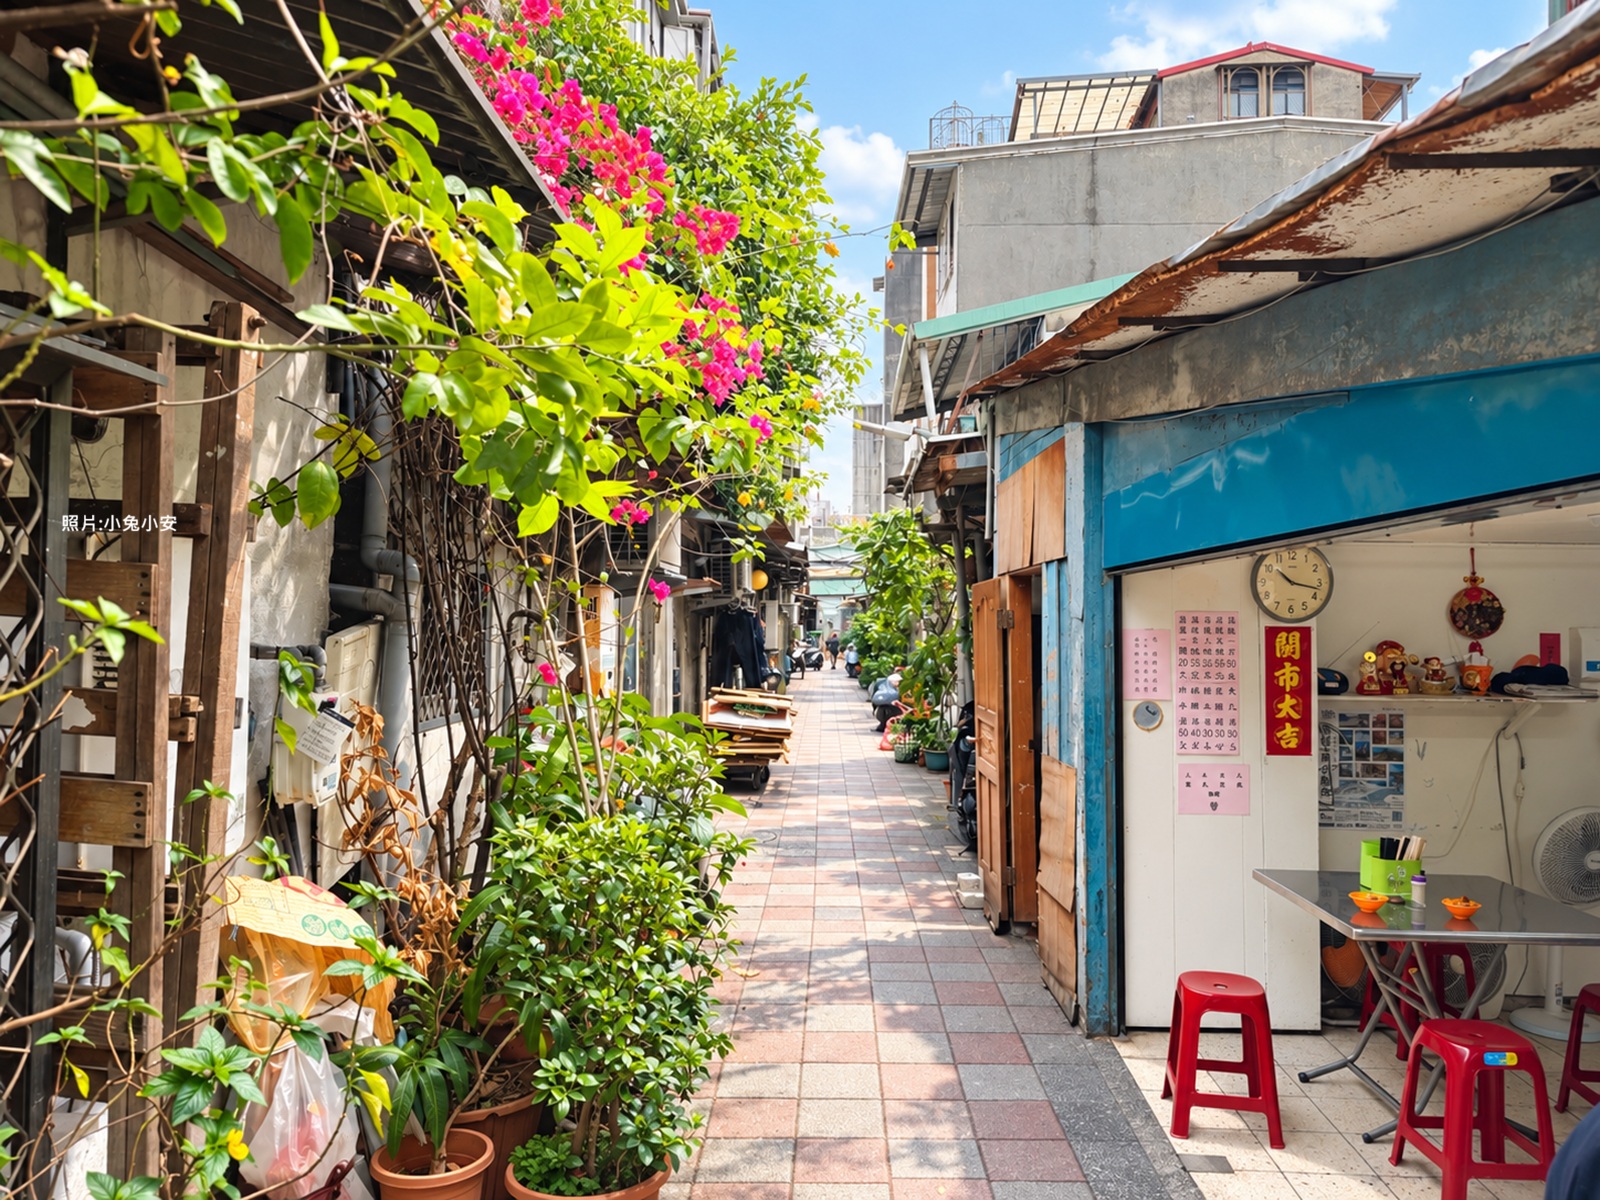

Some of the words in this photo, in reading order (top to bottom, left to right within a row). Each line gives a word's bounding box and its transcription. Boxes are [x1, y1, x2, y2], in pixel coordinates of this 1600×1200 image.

[1275, 552, 1283, 563] 11
[1287, 550, 1297, 560] 12
[1264, 564, 1274, 573] 10
[1312, 563, 1318, 573] 2
[1260, 578, 1266, 587] 9
[1316, 578, 1323, 587] 3
[1264, 591, 1270, 600] 8
[1311, 592, 1317, 601] 4
[1274, 601, 1280, 610] 7
[1287, 605, 1294, 614] 6
[1301, 601, 1308, 611] 5
